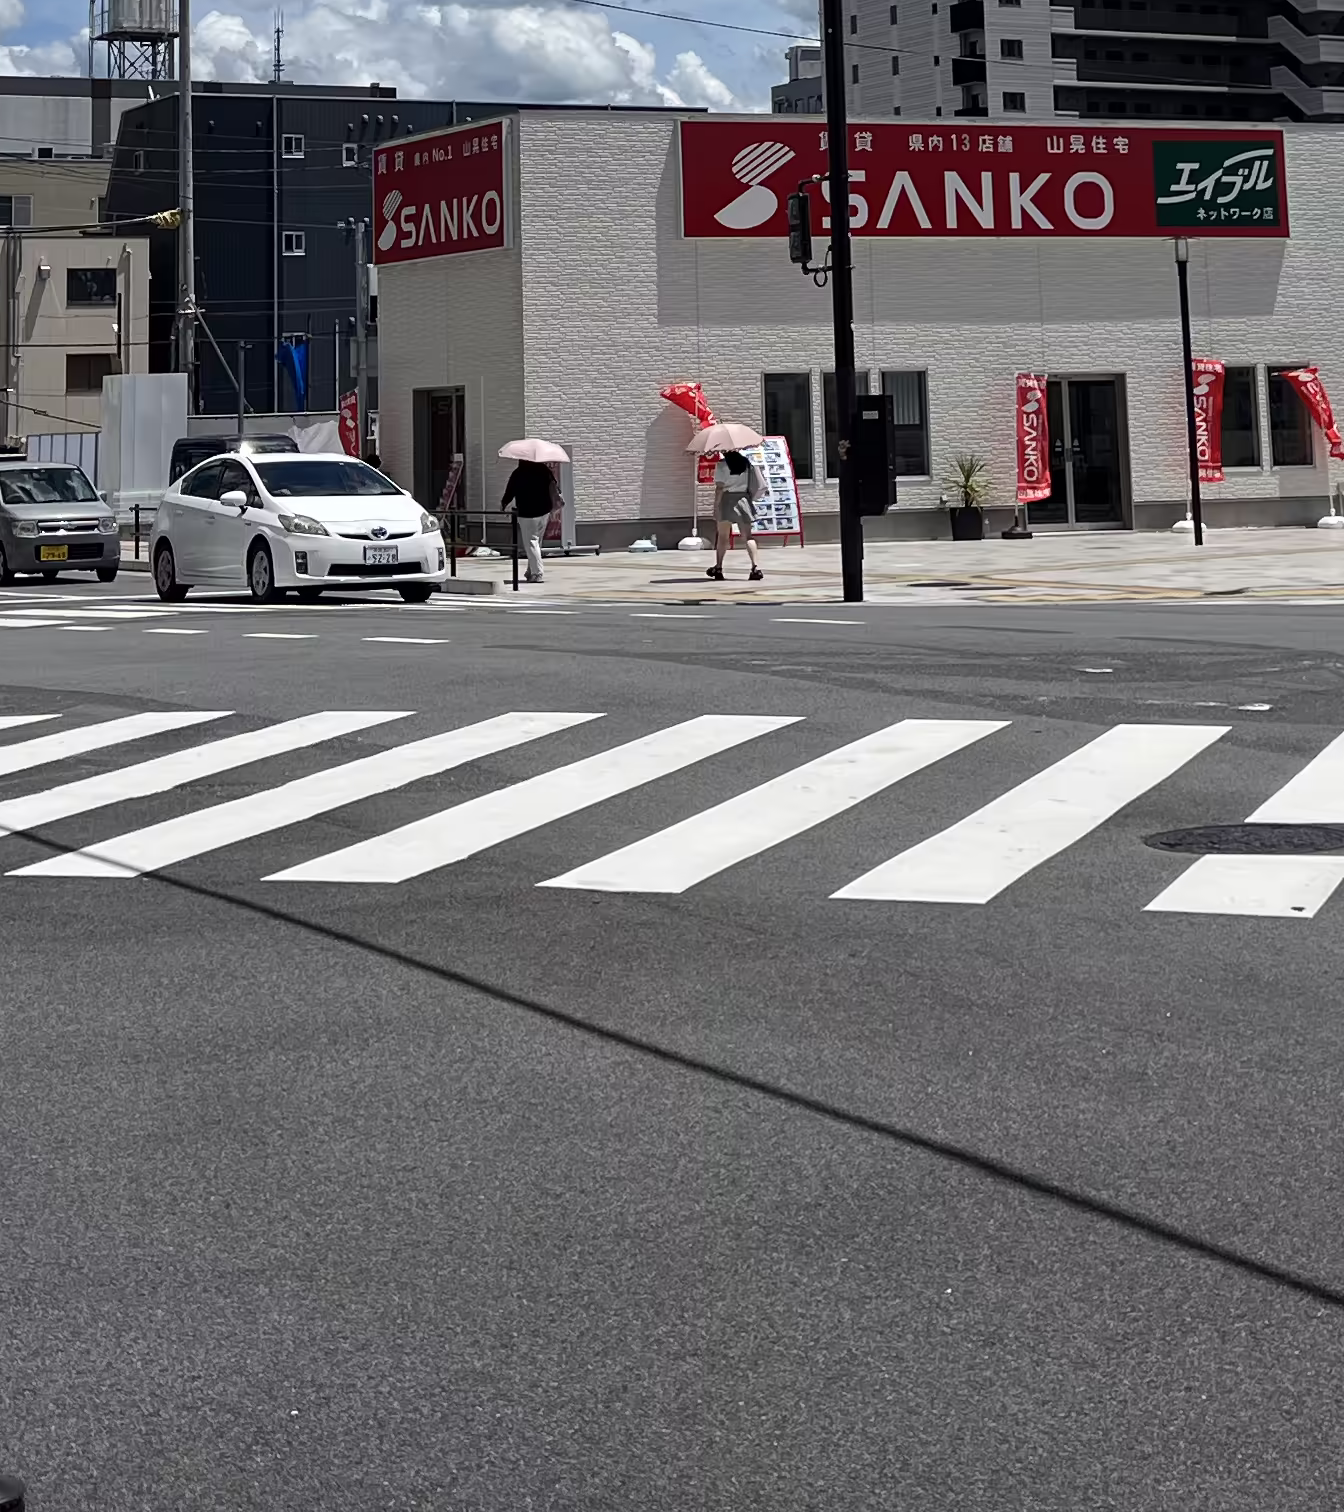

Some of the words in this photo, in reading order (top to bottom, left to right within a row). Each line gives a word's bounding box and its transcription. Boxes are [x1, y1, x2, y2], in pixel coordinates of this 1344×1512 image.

[821, 170, 1114, 230] SANKO
[1162, 152, 1274, 204] エイブル
[400, 190, 501, 248] SANKO
[1196, 207, 1274, 220] ネットワーク店
[1022, 413, 1038, 481] SANKO
[1193, 396, 1209, 461] SANKO
